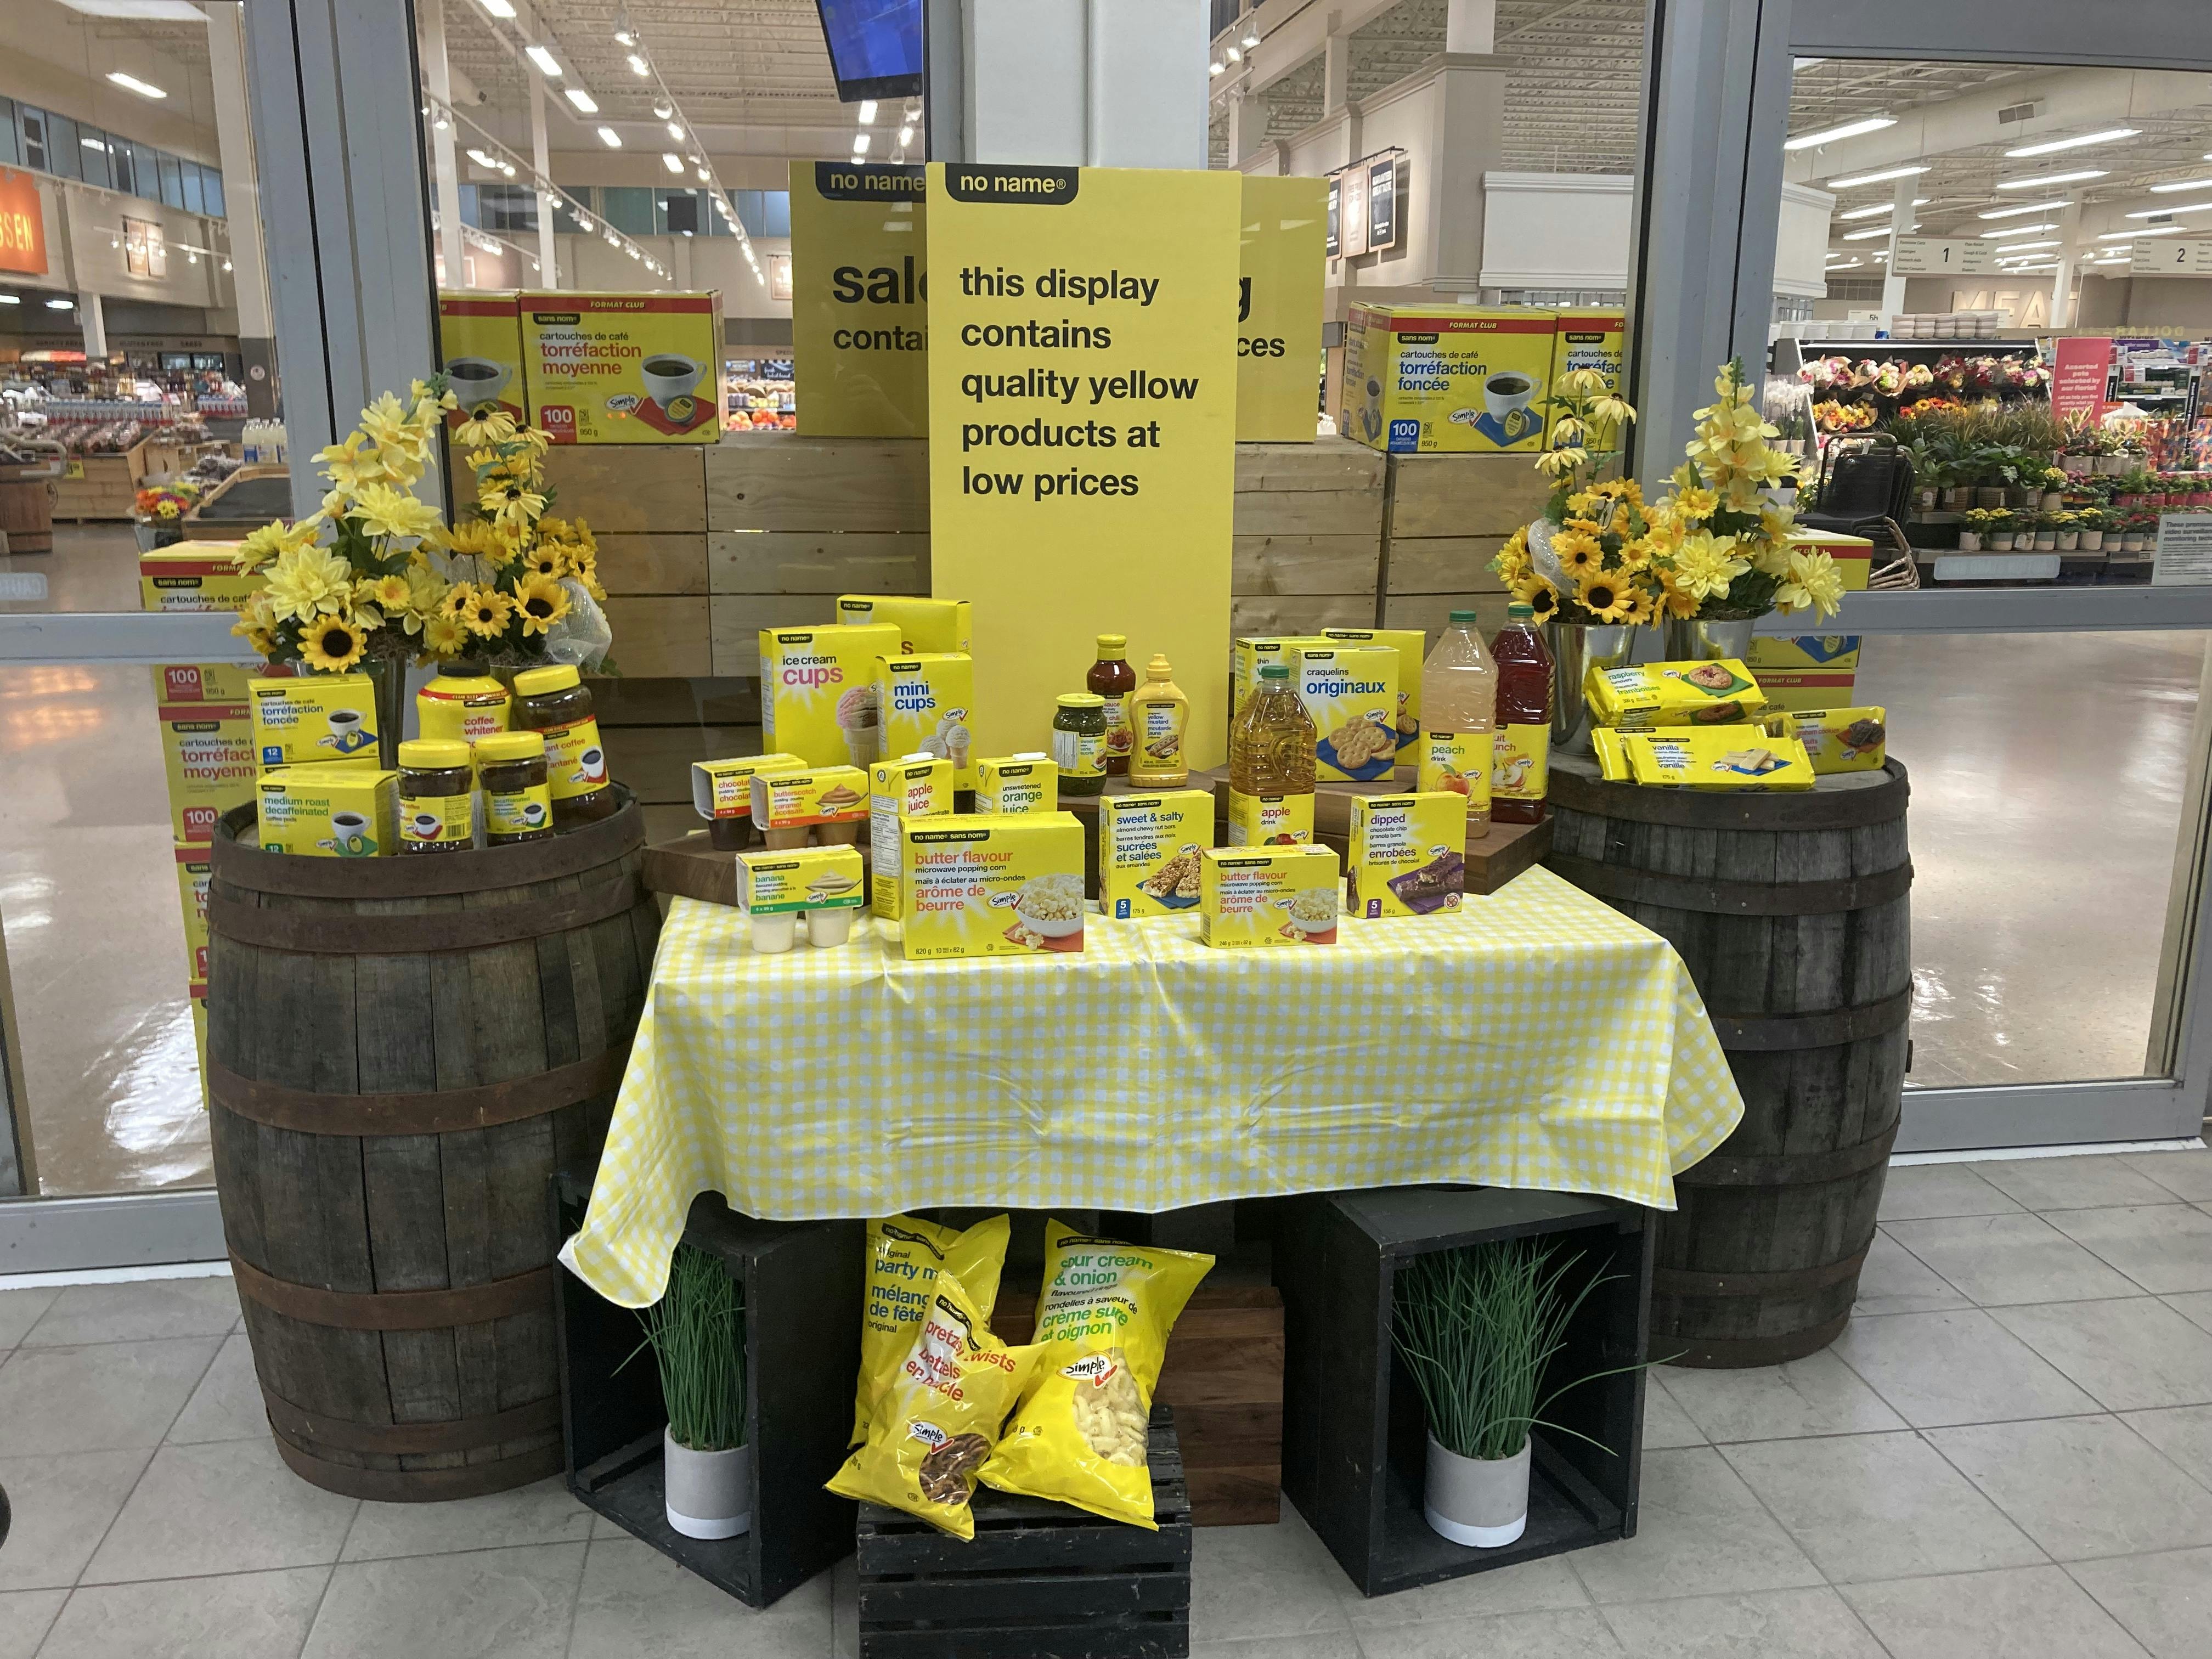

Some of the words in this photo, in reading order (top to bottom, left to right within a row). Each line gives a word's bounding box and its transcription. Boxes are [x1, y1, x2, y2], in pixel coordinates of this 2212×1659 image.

[831, 174, 858, 189] no
[865, 175, 926, 191] name
[961, 176, 988, 191] no
[1943, 247, 1949, 262] 1
[2177, 248, 2186, 262] 2
[960, 267, 1024, 296] this
[1036, 269, 1160, 306] display
[540, 332, 592, 341] cartouches
[609, 332, 629, 341] café
[961, 319, 1111, 349] contains
[541, 343, 642, 358] torréfaction
[543, 363, 622, 377] moyenne
[1400, 361, 1487, 375] torréfaction
[961, 369, 1080, 404] quality
[1088, 370, 1199, 404] yellow
[1398, 377, 1449, 390] foncée
[611, 396, 635, 408] Simple
[545, 410, 572, 422] 100
[1452, 410, 1475, 421] Simple
[963, 418, 1116, 452] products
[1127, 421, 1160, 448] at
[1393, 424, 1417, 436] 100
[963, 466, 1023, 494] low
[1035, 467, 1139, 501] prices
[782, 656, 799, 665] ice
[801, 655, 836, 664] cream
[169, 669, 197, 683] 100
[783, 667, 843, 689] cups
[1307, 668, 1348, 676] craquelins
[1609, 671, 1645, 680] raspberry
[895, 681, 929, 696] mini
[1306, 679, 1385, 697] originaux
[262, 704, 323, 716] torréfaction
[895, 696, 935, 712] cups
[946, 709, 963, 719] Simple
[263, 716, 298, 725] foncée
[465, 716, 494, 725] coffee
[465, 725, 503, 735] whitener
[1431, 745, 1465, 755] peach
[774, 788, 816, 797] butterscotch
[908, 784, 933, 798] apple
[1003, 791, 1042, 803] orange
[264, 797, 302, 805] medium
[907, 799, 929, 814] juice
[266, 806, 329, 816] decaffeinated
[1262, 807, 1290, 819] apple
[1117, 814, 1147, 825] sweet
[1150, 813, 1157, 822] &
[1160, 812, 1184, 822] salty
[1371, 814, 1406, 826] dipped
[1116, 842, 1156, 852] sucrées
[1369, 848, 1416, 858] enrobées
[916, 853, 959, 864] butter
[963, 851, 1013, 863] flavour
[1129, 850, 1161, 861] salées
[958, 865, 988, 873] popping
[755, 874, 785, 883] banana
[1221, 873, 1250, 881] butter
[1253, 871, 1287, 879] flavour
[916, 886, 963, 898] arôme
[968, 884, 985, 896] de
[992, 893, 1015, 905] Simple
[1220, 896, 1252, 904] arôme
[917, 900, 964, 911] beurre
[1060, 1255, 1093, 1269] sour
[875, 1259, 919, 1280] party
[1054, 1274, 1066, 1286] &
[1070, 1269, 1117, 1285] onion
[1051, 1287, 1094, 1297] flavoured
[1045, 1299, 1085, 1311] rondelles
[1087, 1296, 1093, 1305] à
[1096, 1296, 1128, 1305] saveur
[1128, 1301, 1138, 1314] de
[870, 1301, 889, 1317] de
[894, 1305, 924, 1322] fête
[1043, 1308, 1092, 1328] crème
[1095, 1306, 1128, 1326] sure
[868, 1321, 897, 1333] original
[1041, 1331, 1054, 1342] et
[1057, 1322, 1111, 1341] oignon
